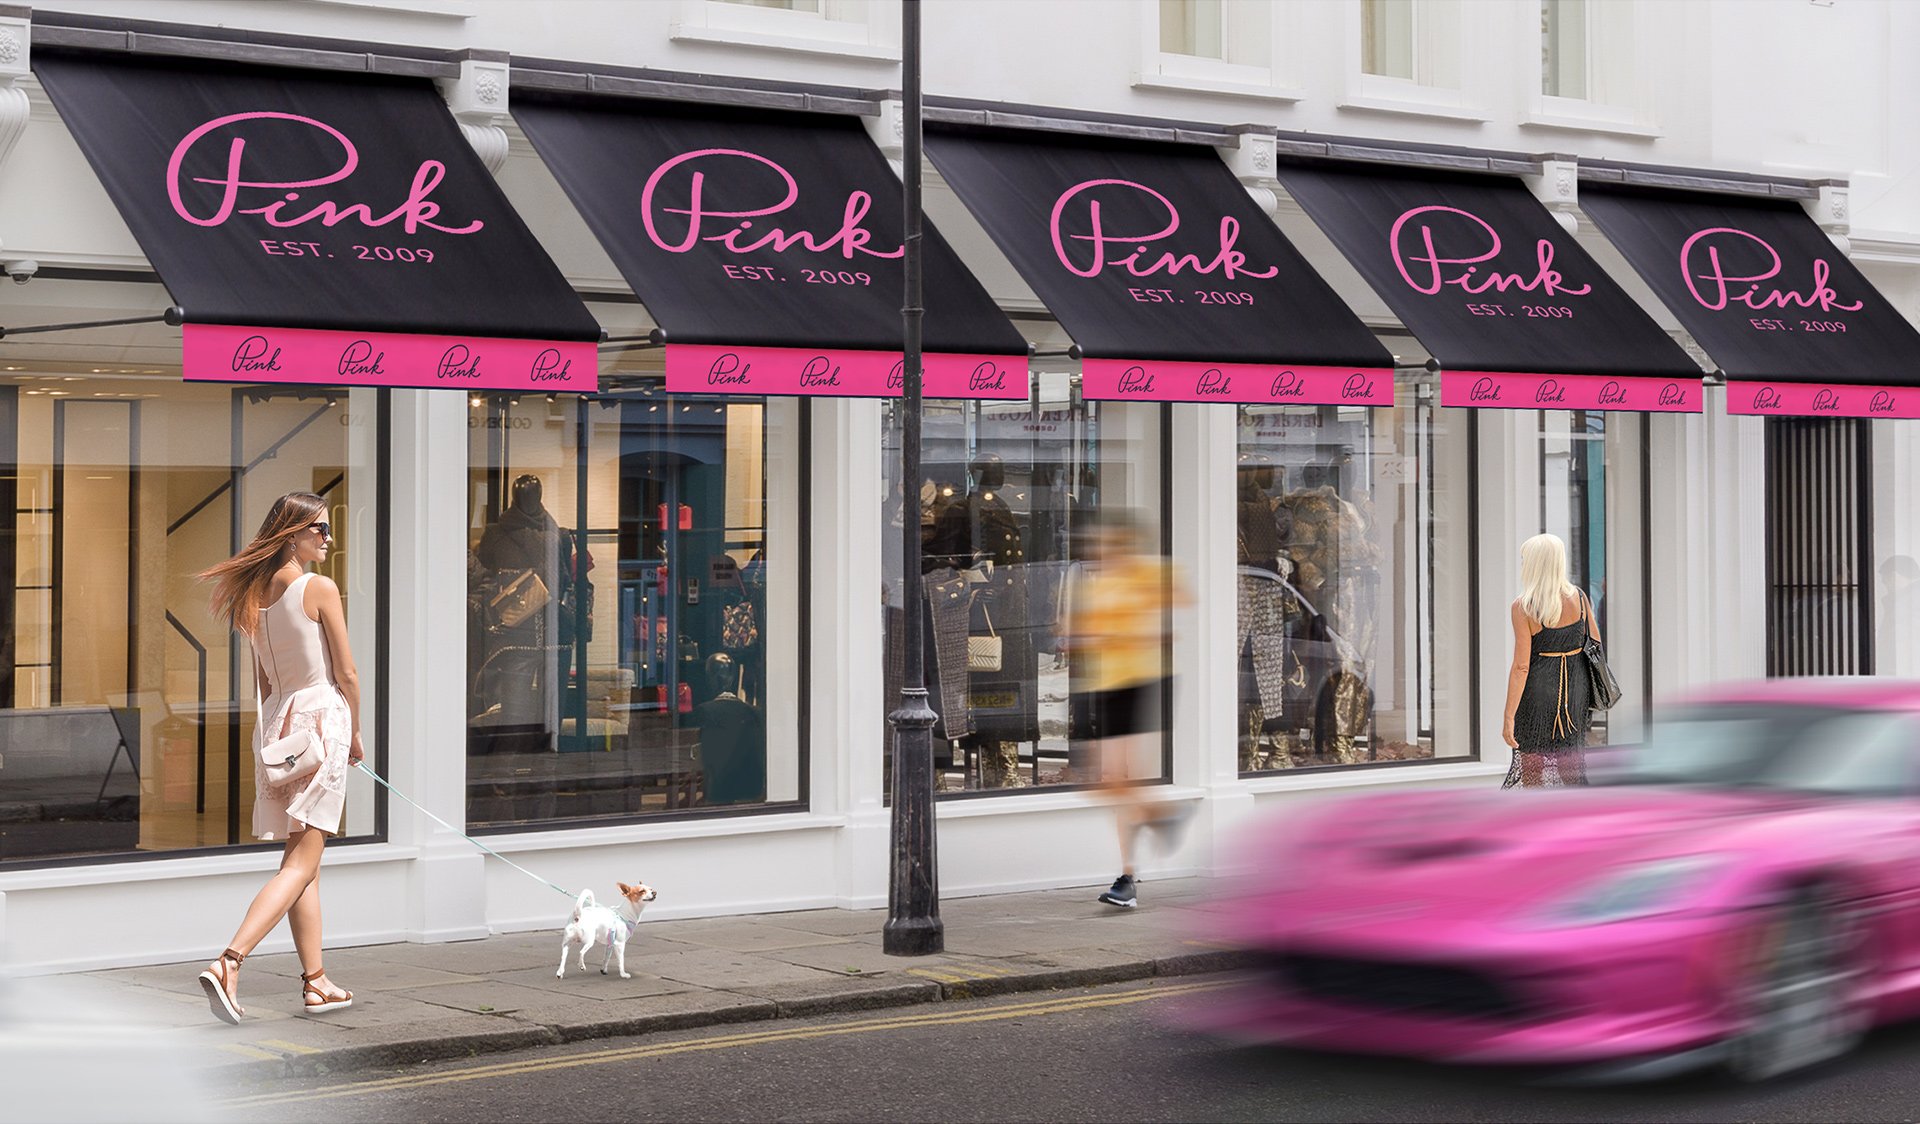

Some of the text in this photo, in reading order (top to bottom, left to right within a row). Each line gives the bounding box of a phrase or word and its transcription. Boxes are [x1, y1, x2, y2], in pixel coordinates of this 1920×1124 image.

[166, 112, 484, 234] Pink
[641, 149, 905, 260] Pink
[1050, 179, 1278, 281] Pink
[260, 240, 435, 264] EST. 2009
[1390, 206, 1591, 296] Pink
[723, 264, 872, 286] EST. 2009
[1680, 228, 1863, 311] Pink
[1128, 287, 1255, 305] EST. 2009
[1467, 303, 1573, 318] EST. 2009
[1749, 319, 1848, 333] EST. 2009
[232, 336, 281, 372] Pink
[338, 340, 384, 376] Pink
[438, 344, 480, 379] Pink
[531, 348, 571, 382] Pink
[708, 353, 750, 385] Pink
[800, 356, 840, 388] Pink
[969, 361, 1006, 391] Pink
[1118, 366, 1155, 394] Pink
[1195, 369, 1230, 395] Pink
[1271, 371, 1305, 397] Pink
[1342, 373, 1373, 399] Pink
[1470, 378, 1500, 402] Pink
[1535, 379, 1565, 403] Pink
[1598, 381, 1627, 405] Pink
[1658, 383, 1685, 407] Pink
[1753, 386, 1781, 409] Pink
[1812, 388, 1839, 411] Pink
[1869, 390, 1895, 413] Pink
